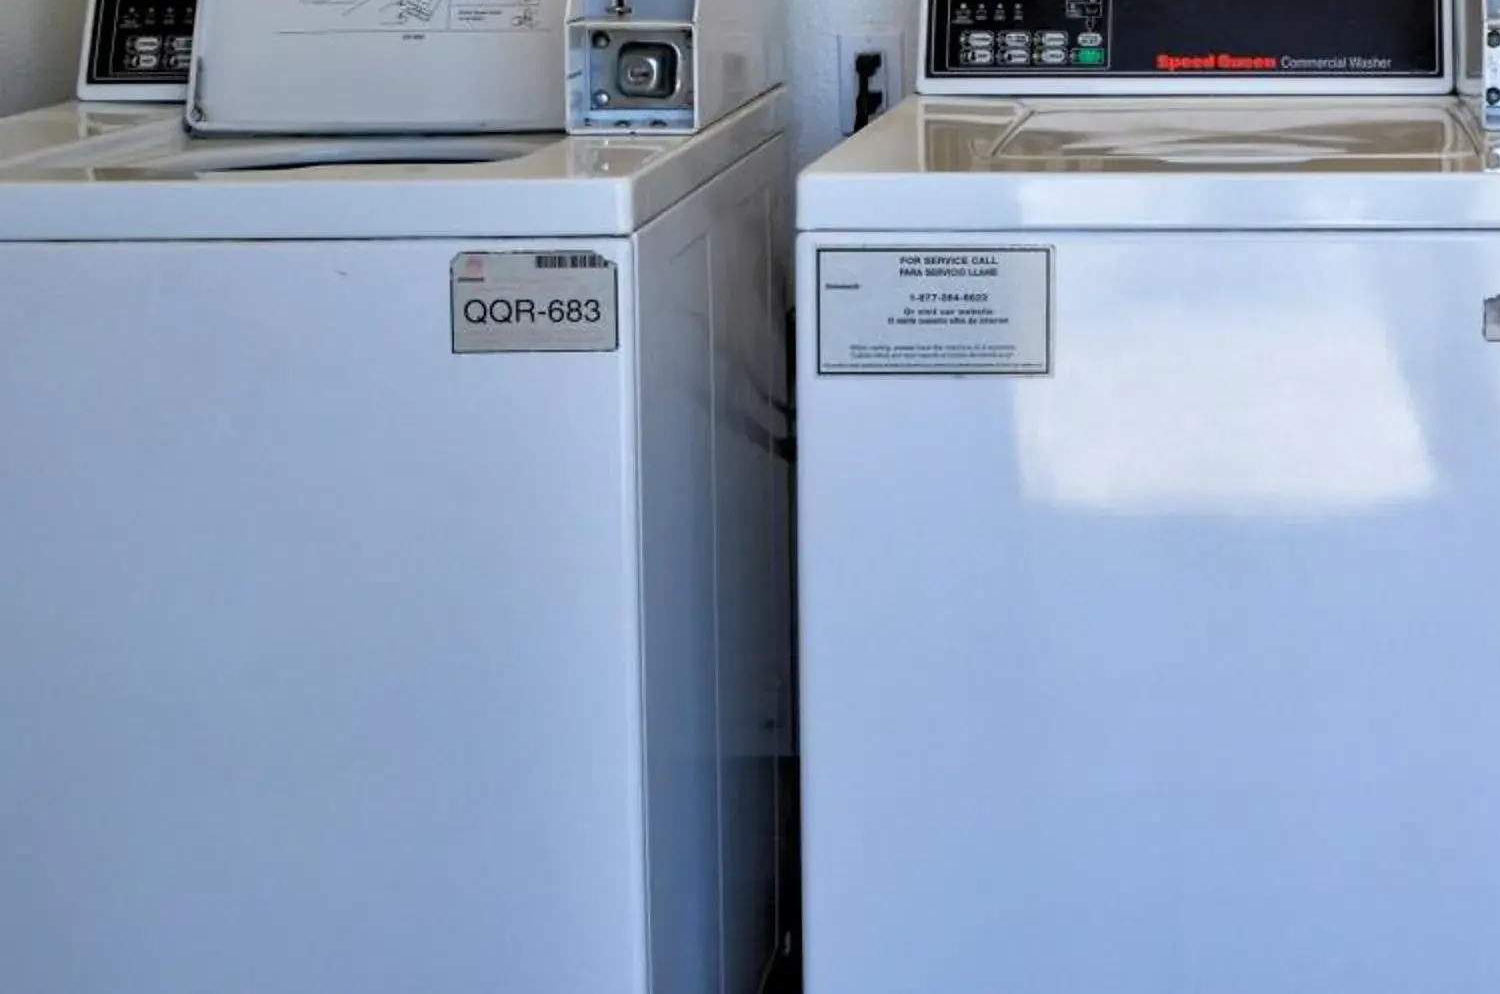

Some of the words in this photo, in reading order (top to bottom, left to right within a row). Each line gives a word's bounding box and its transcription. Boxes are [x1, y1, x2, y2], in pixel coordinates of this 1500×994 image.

[1156, 54, 1214, 71] Speed
[1217, 54, 1277, 70] Queen
[1280, 55, 1347, 69] Commercial
[1349, 55, 1393, 69] Washer
[899, 256, 920, 266] FOR
[924, 256, 968, 266] SERVICE
[971, 256, 999, 266] CALL
[899, 268, 922, 277] PARA
[925, 268, 966, 277] SERVICIO
[969, 268, 999, 277] LLAME
[463, 299, 601, 324] QQR-683
